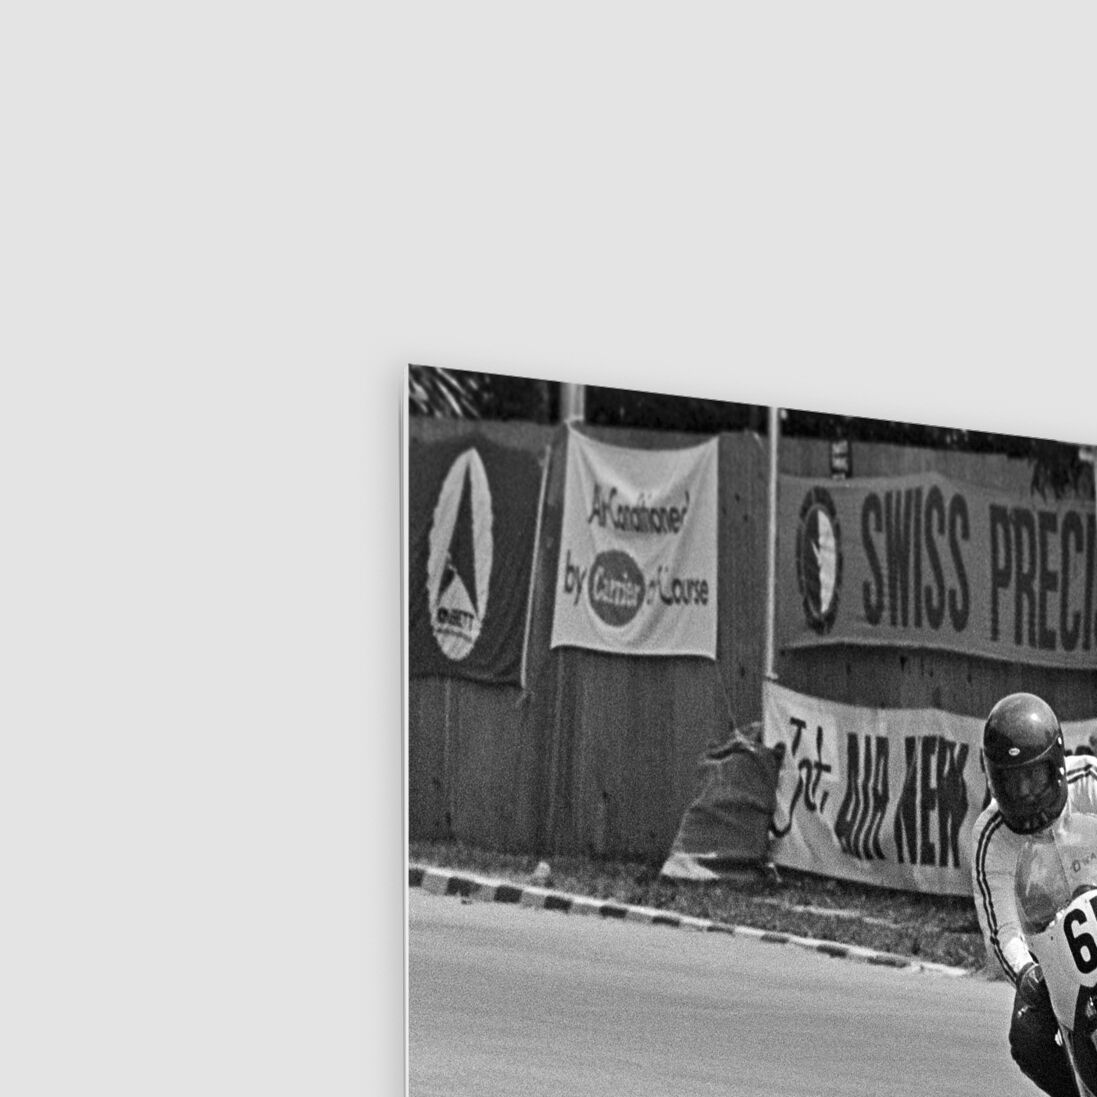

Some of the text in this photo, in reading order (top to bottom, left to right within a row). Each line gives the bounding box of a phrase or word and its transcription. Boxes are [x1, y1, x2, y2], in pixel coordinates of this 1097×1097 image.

[564, 550, 588, 606] by
[862, 485, 970, 632] SWISS
[834, 732, 890, 860] AIR
[894, 735, 969, 869] NEW
